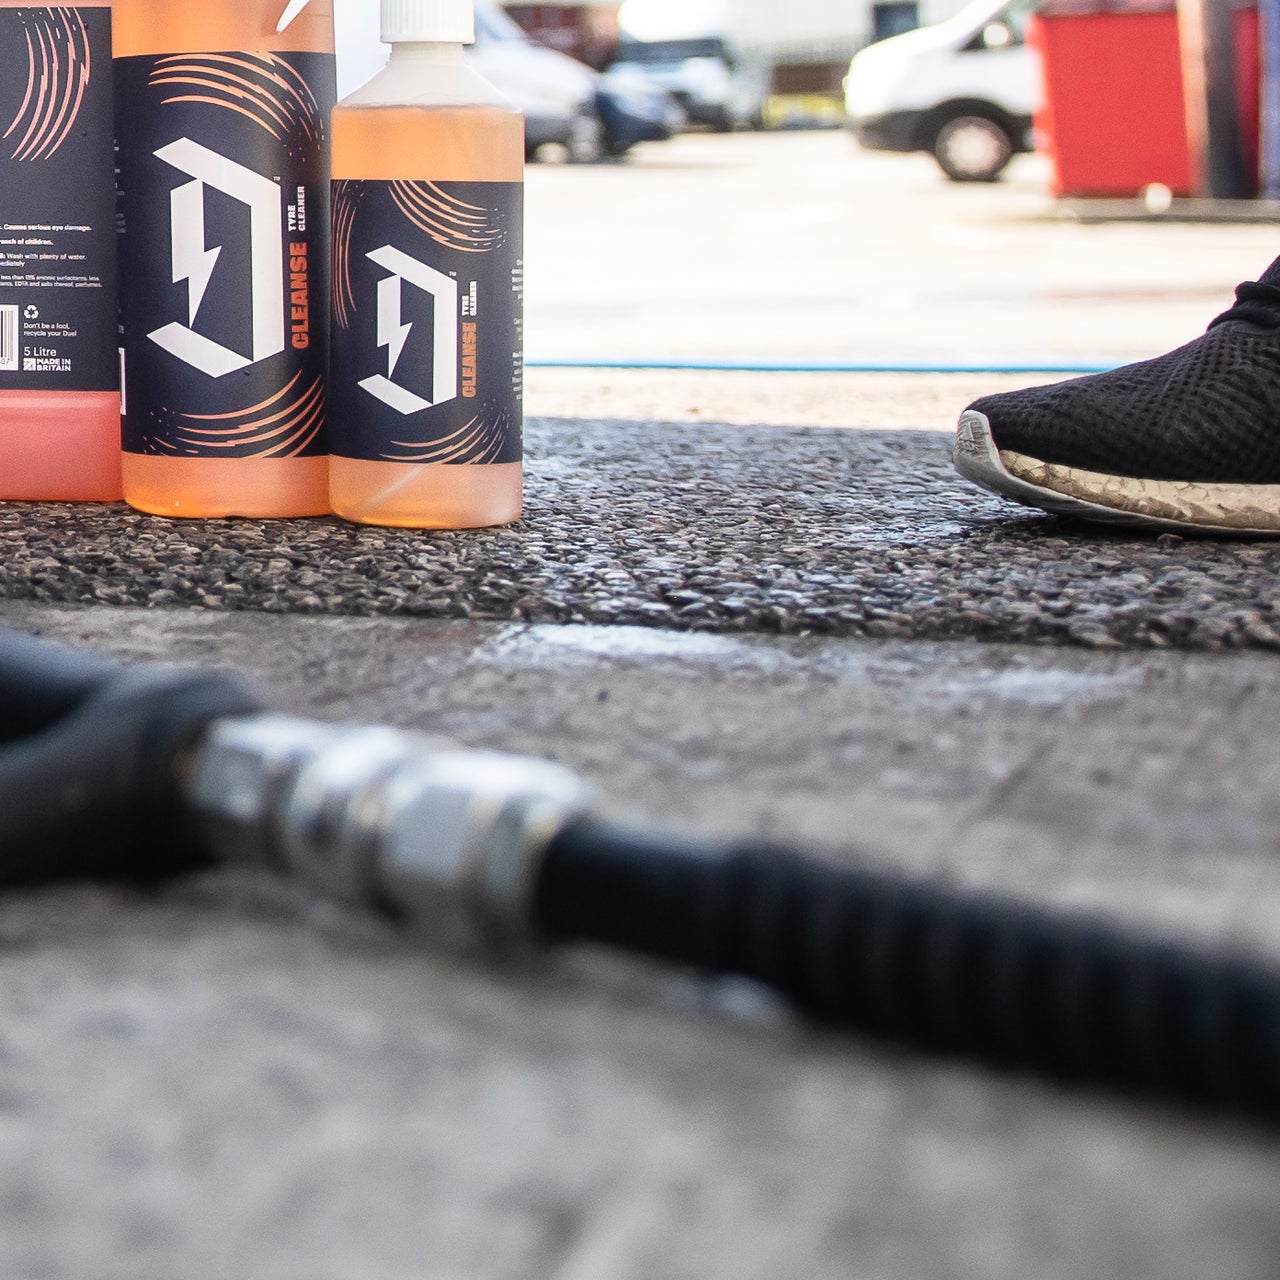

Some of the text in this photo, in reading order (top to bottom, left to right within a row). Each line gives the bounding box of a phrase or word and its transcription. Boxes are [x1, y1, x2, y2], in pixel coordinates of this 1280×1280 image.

[288, 204, 296, 231] TYRE
[289, 242, 308, 350] CLEANSE
[23, 347, 57, 357] 5 Litre
[462, 322, 477, 398] CLEANSE
